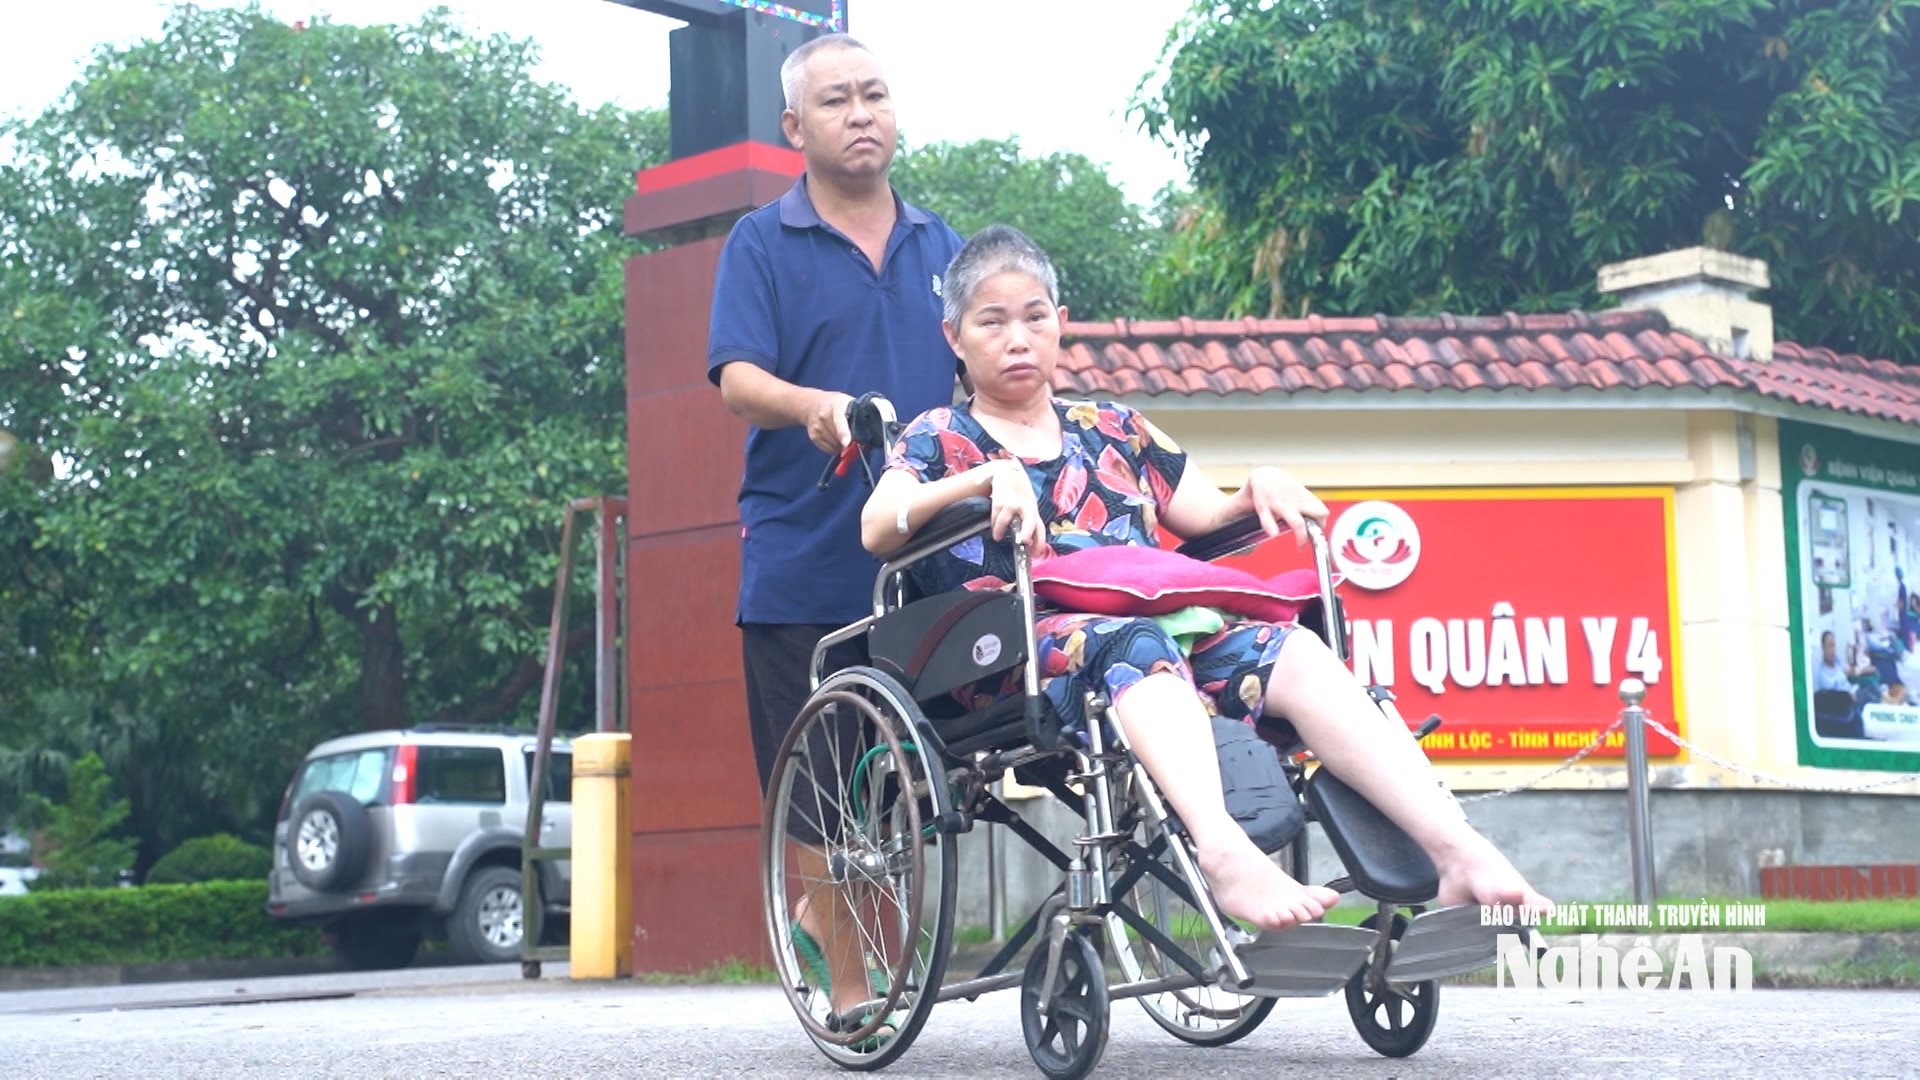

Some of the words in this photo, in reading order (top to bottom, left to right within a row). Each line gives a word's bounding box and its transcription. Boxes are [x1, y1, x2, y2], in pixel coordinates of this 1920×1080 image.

[1409, 601, 1568, 694] QUÂN
[1581, 616, 1618, 684] Y
[1626, 616, 1663, 684] 4
